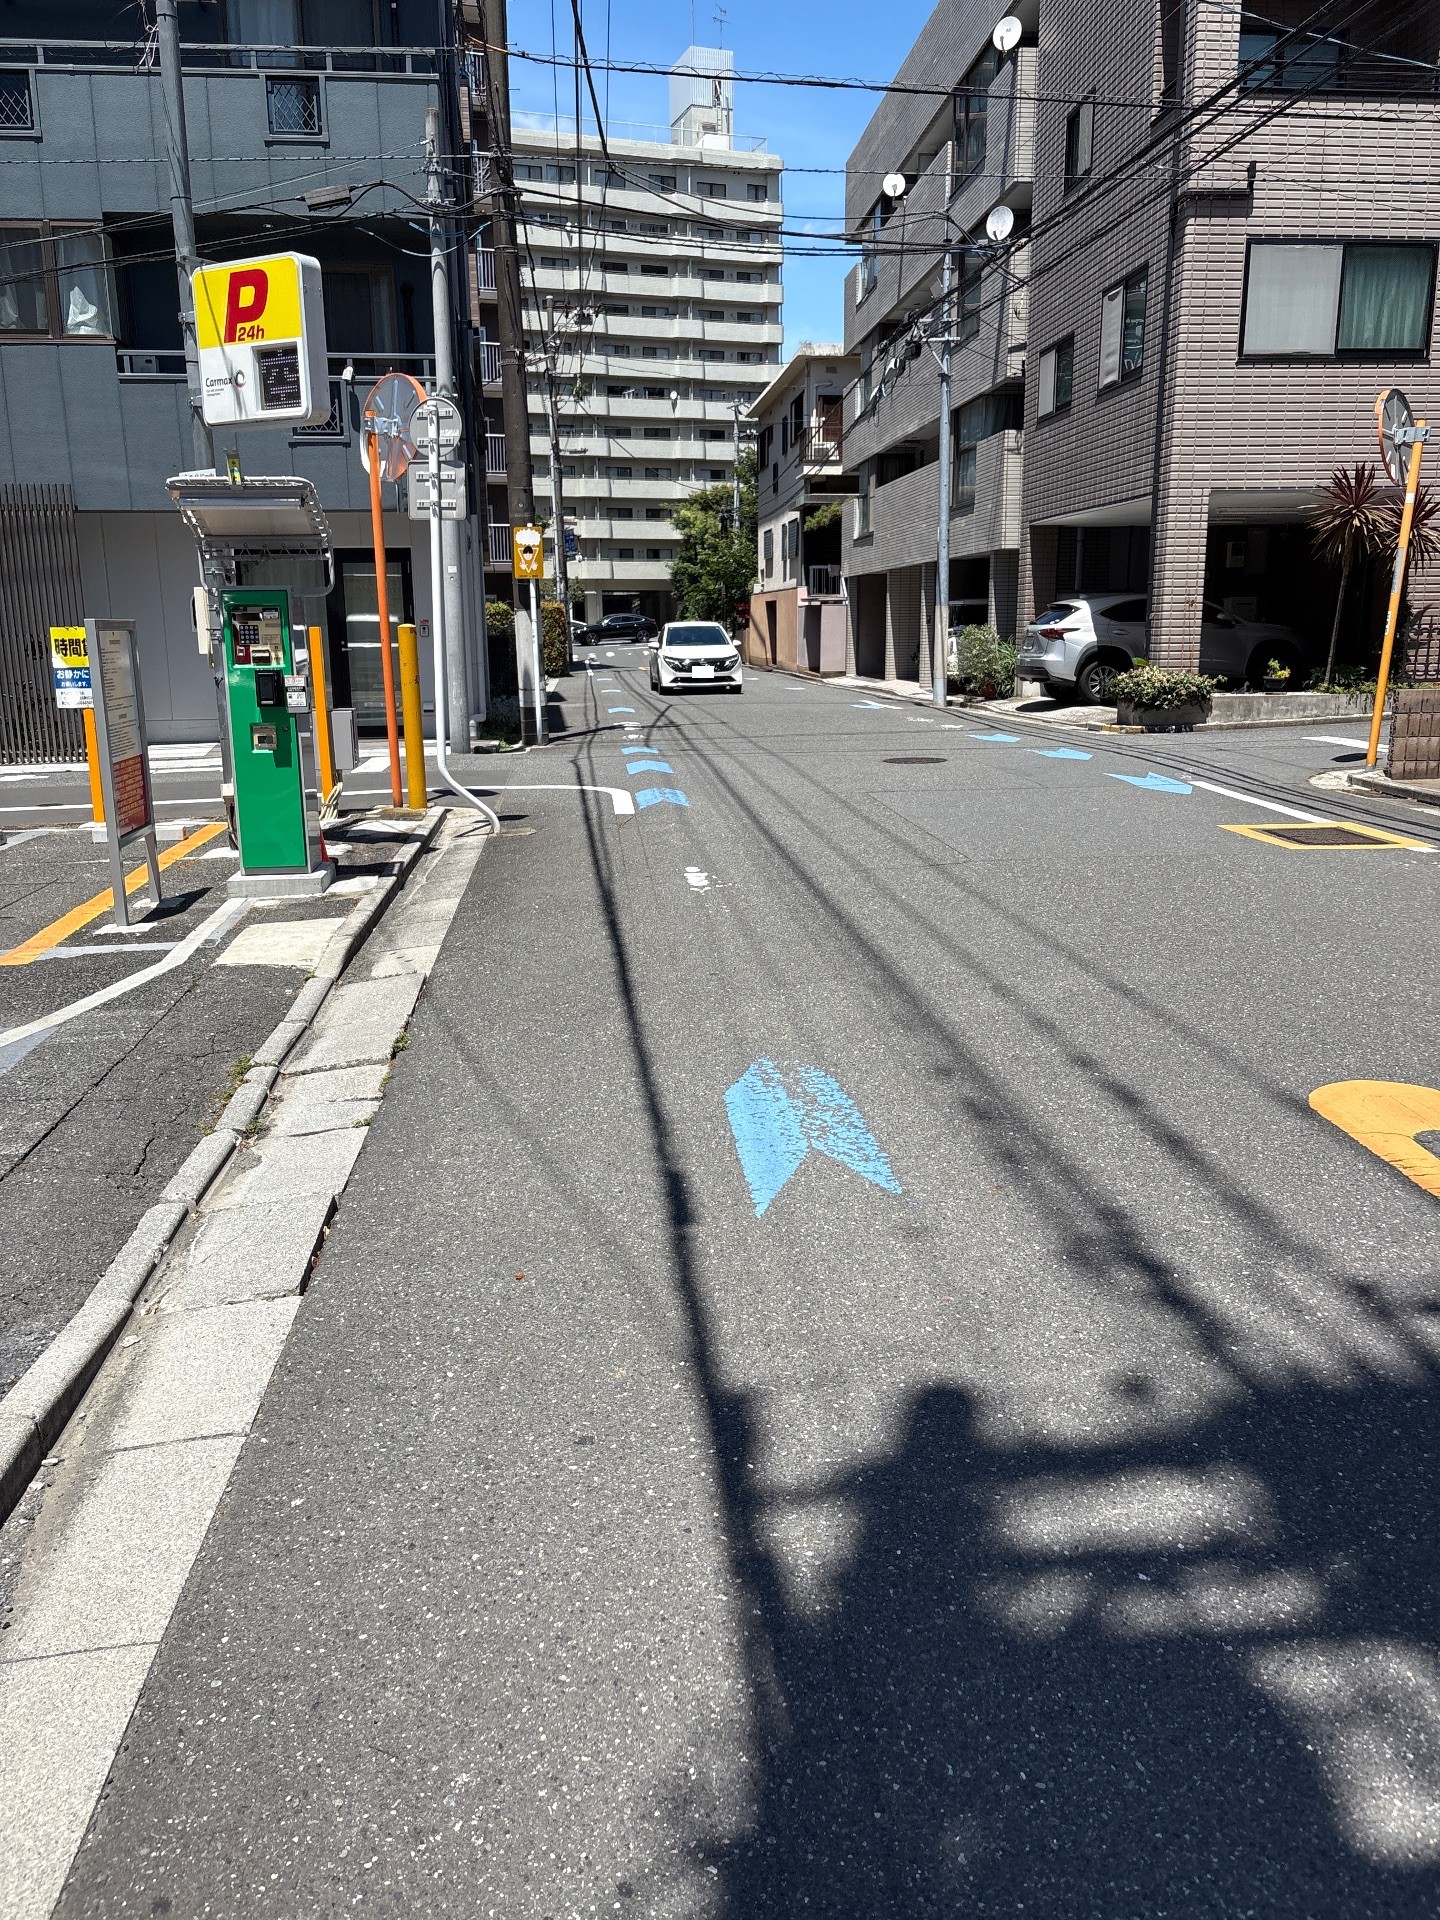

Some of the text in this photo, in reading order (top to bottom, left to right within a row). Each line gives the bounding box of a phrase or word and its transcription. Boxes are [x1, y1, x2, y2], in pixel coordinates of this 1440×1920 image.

[223, 268, 269, 344] P
[237, 324, 265, 342] 24h
[205, 377, 233, 388] Carmax
[56, 669, 90, 680] お静かに
